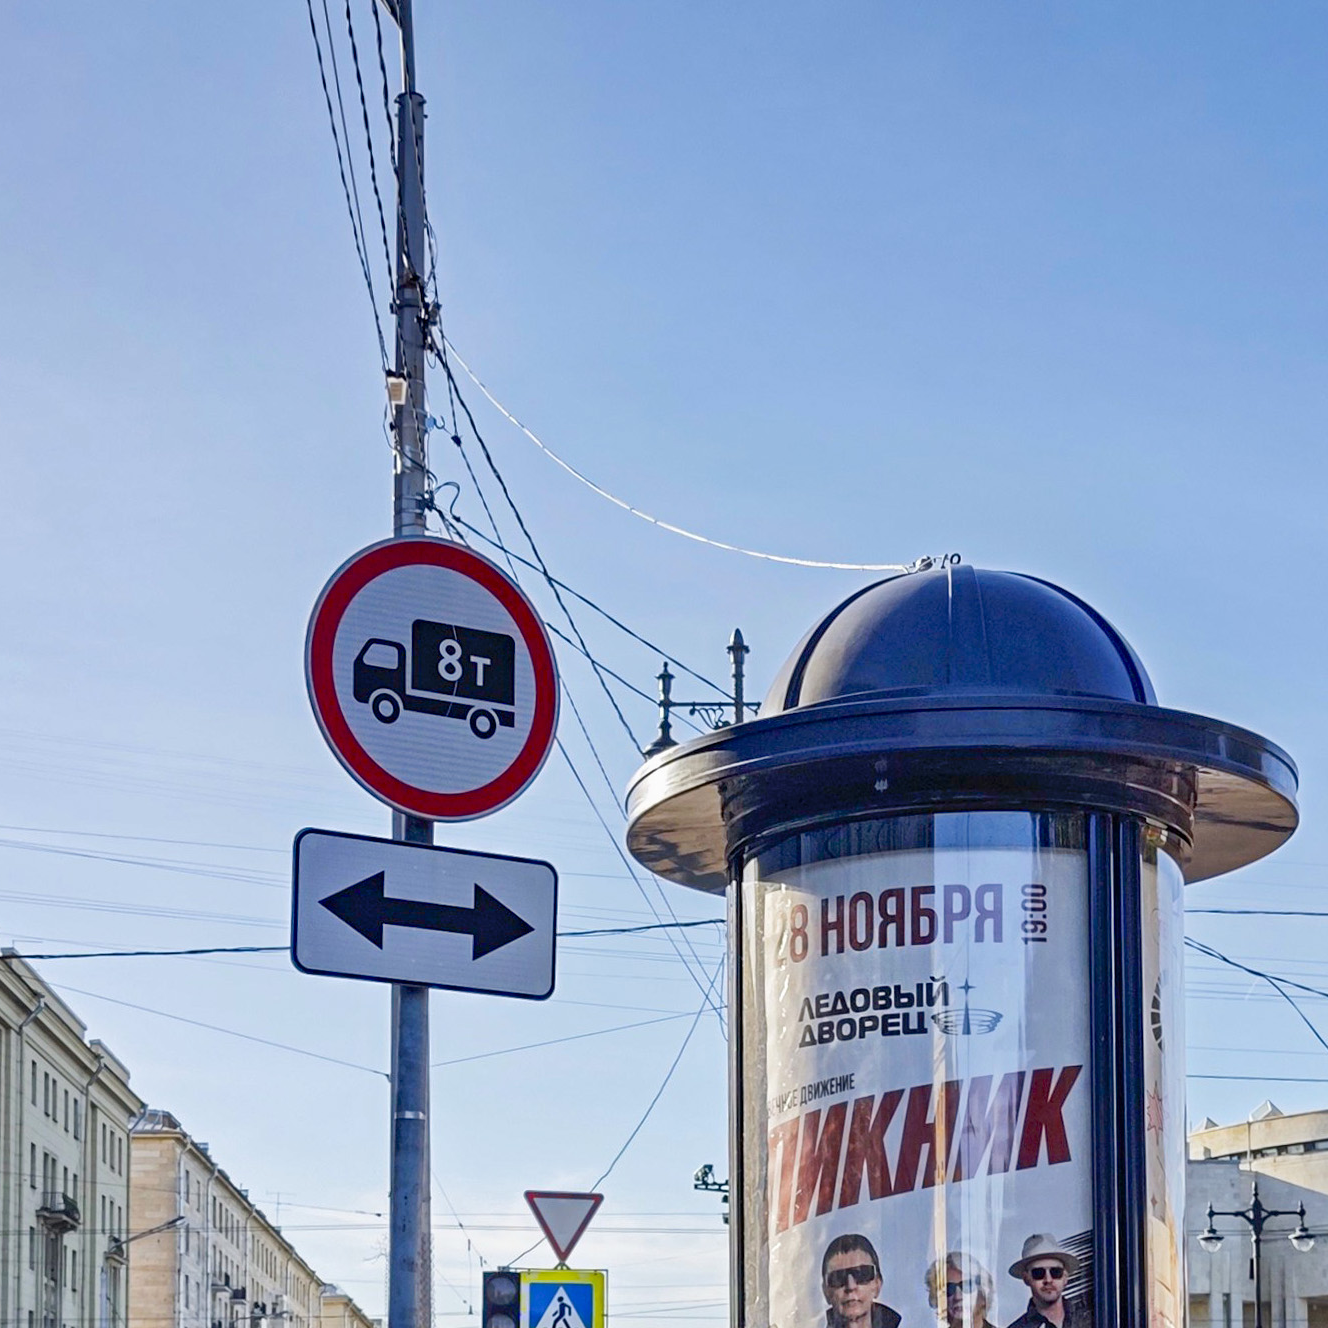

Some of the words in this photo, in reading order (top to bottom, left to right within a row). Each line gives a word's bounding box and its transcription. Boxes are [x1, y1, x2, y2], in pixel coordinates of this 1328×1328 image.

[820, 884, 1004, 957] НОЯБРЯ
[1021, 884, 1048, 946] 19:00
[798, 976, 950, 1022] ЛЕДОВЫЙ
[799, 1011, 928, 1048] ДВОРЕЦ
[800, 1073, 855, 1107] ДВИЖЕНИЕ
[768, 1065, 1084, 1235] ПИКНИК
